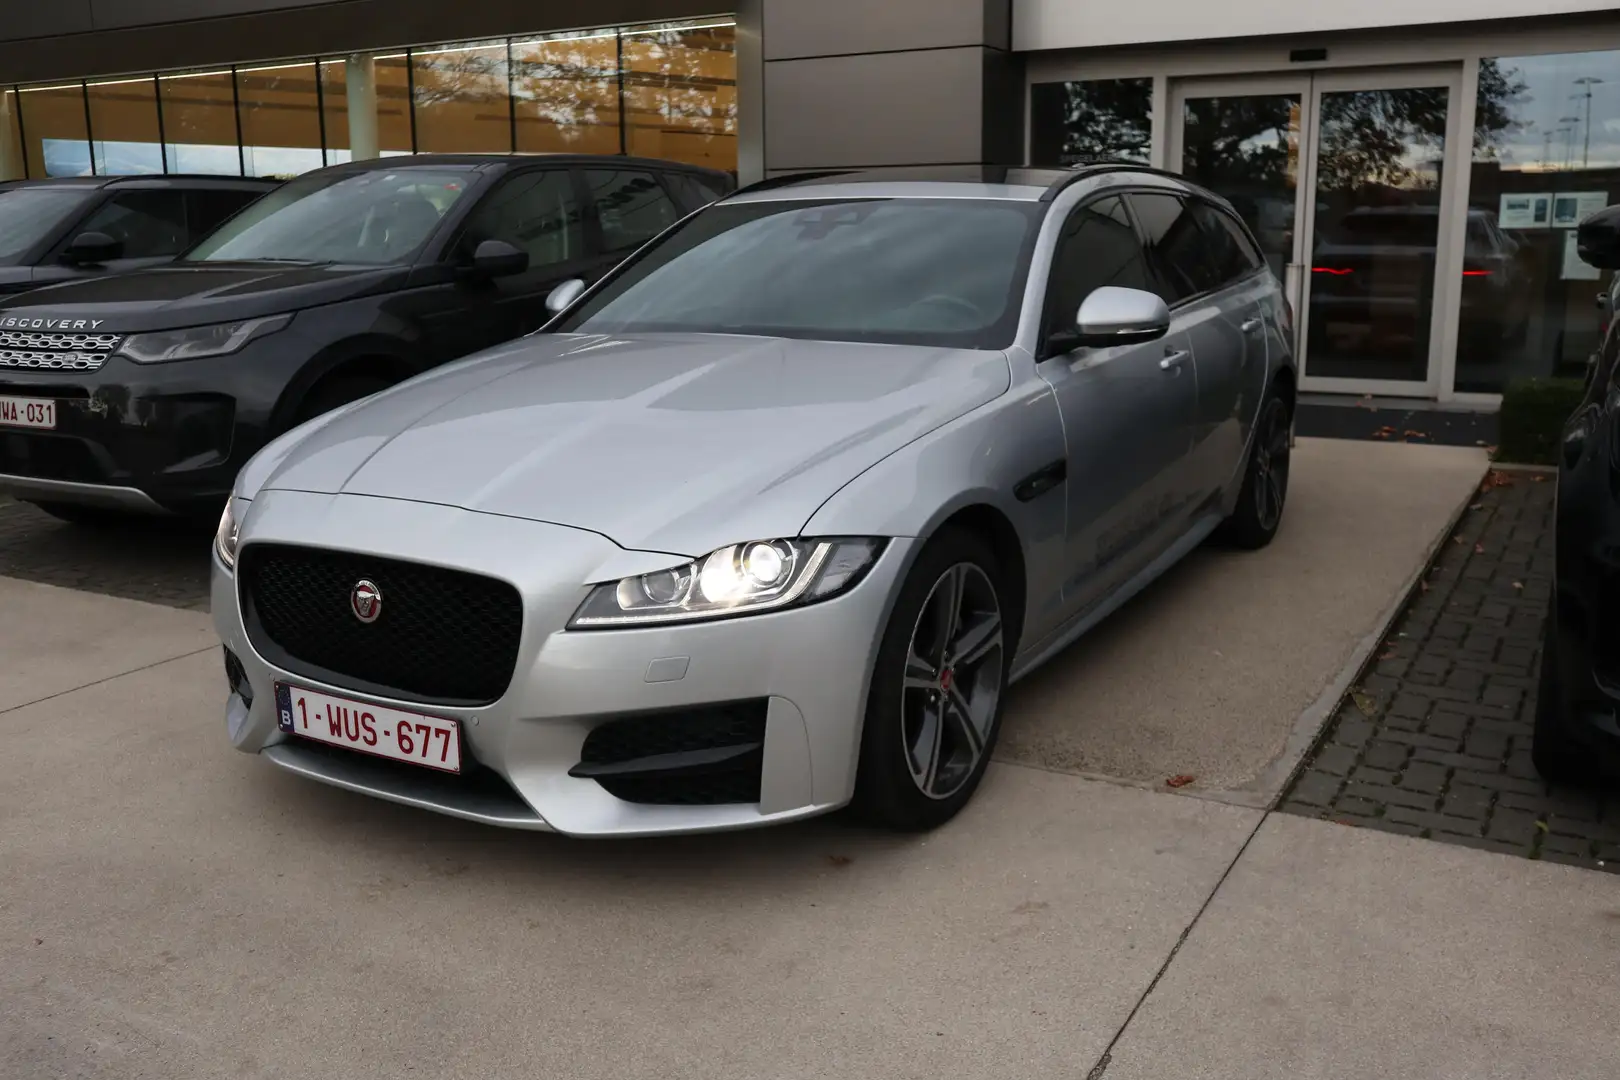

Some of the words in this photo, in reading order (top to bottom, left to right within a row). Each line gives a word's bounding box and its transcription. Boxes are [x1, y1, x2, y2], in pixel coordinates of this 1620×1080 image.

[0, 317, 104, 329] ISCOVERY
[0, 401, 52, 424] WA-031
[281, 709, 292, 725] B
[297, 697, 451, 762] 1-WUS-677
